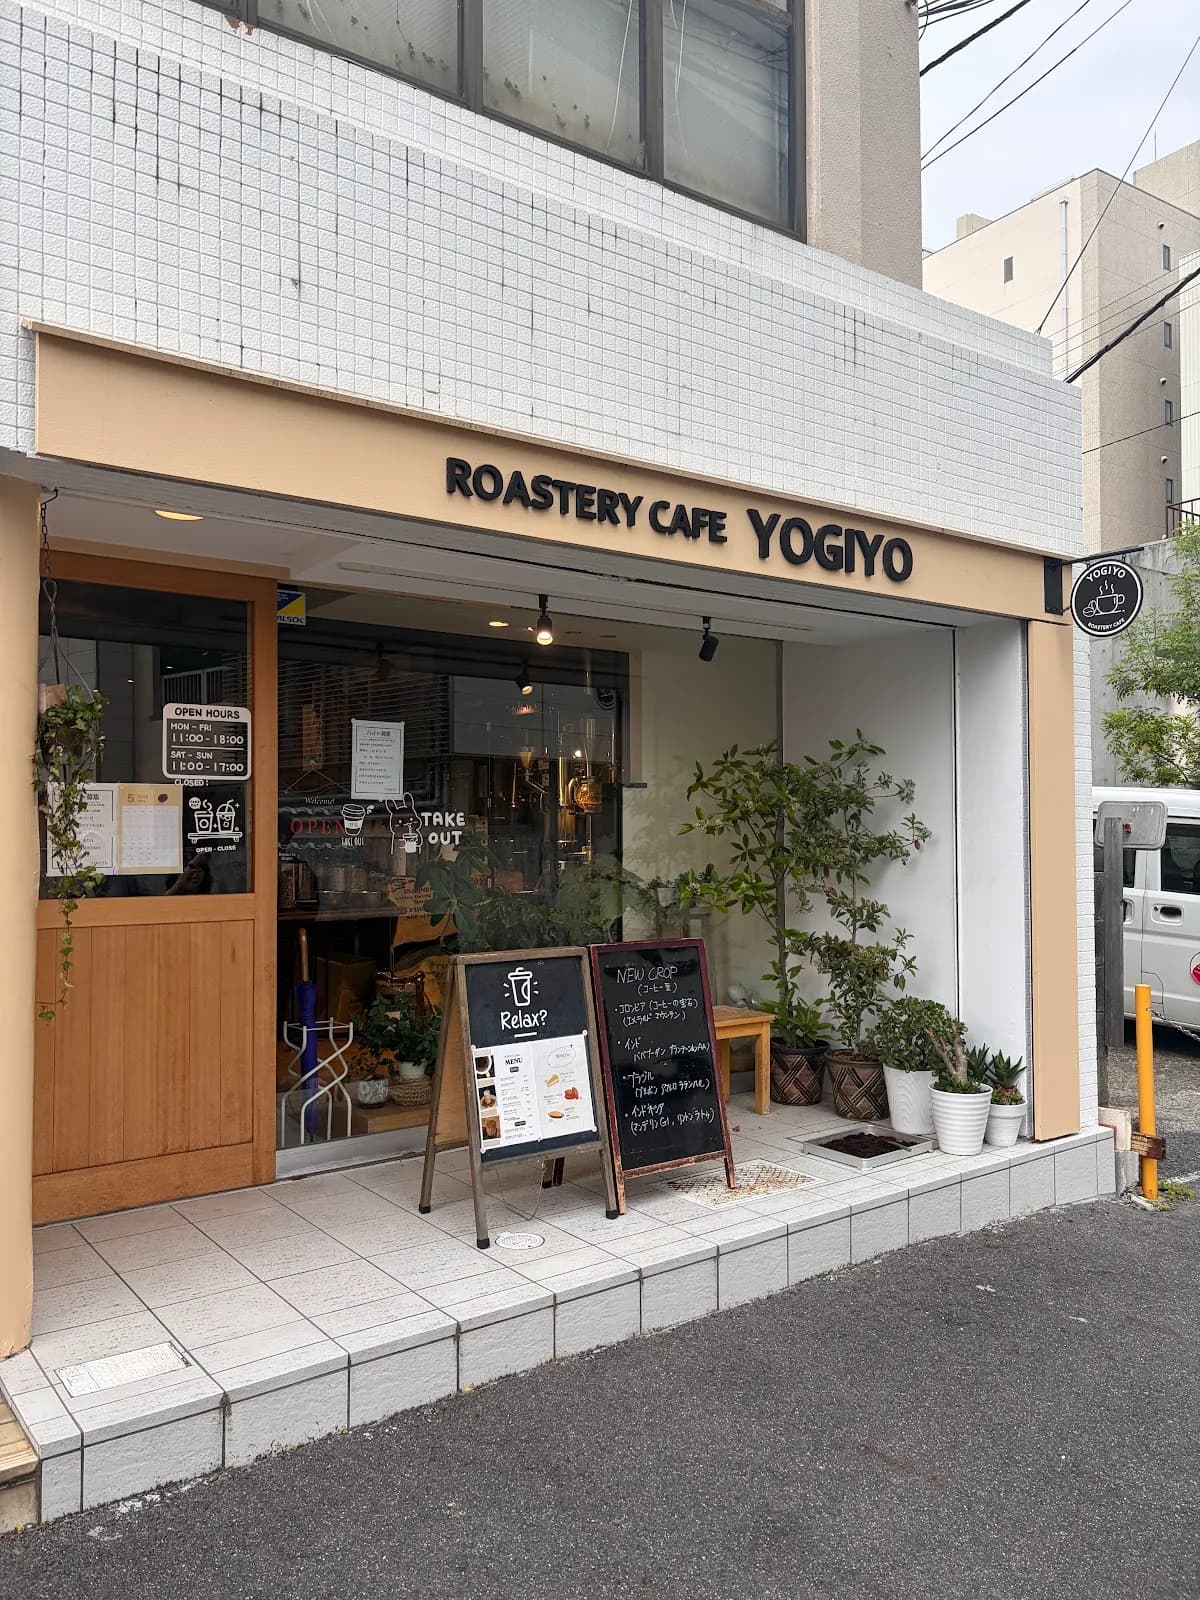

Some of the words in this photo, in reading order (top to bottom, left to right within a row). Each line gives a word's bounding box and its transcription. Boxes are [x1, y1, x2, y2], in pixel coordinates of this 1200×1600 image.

[445, 456, 644, 527] ROASTERY
[648, 500, 728, 543] CAFE
[746, 509, 914, 582] YOGIYO
[1086, 566, 1126, 582] YOGIYO
[174, 707, 202, 717] OPEN
[206, 709, 240, 719] HOURS
[170, 722, 189, 731] MON
[199, 723, 212, 731] FRI
[170, 750, 186, 759] SAT
[195, 751, 213, 759] SUN
[127, 793, 135, 803] 5
[421, 811, 466, 827] TAKE
[427, 830, 463, 845] OUT
[617, 967, 645, 984] NEW
[648, 966, 678, 981] CROP
[637, 982, 678, 996] (コーヒー豆)
[500, 1009, 548, 1031] Relax?
[505, 1057, 523, 1065] MENU
